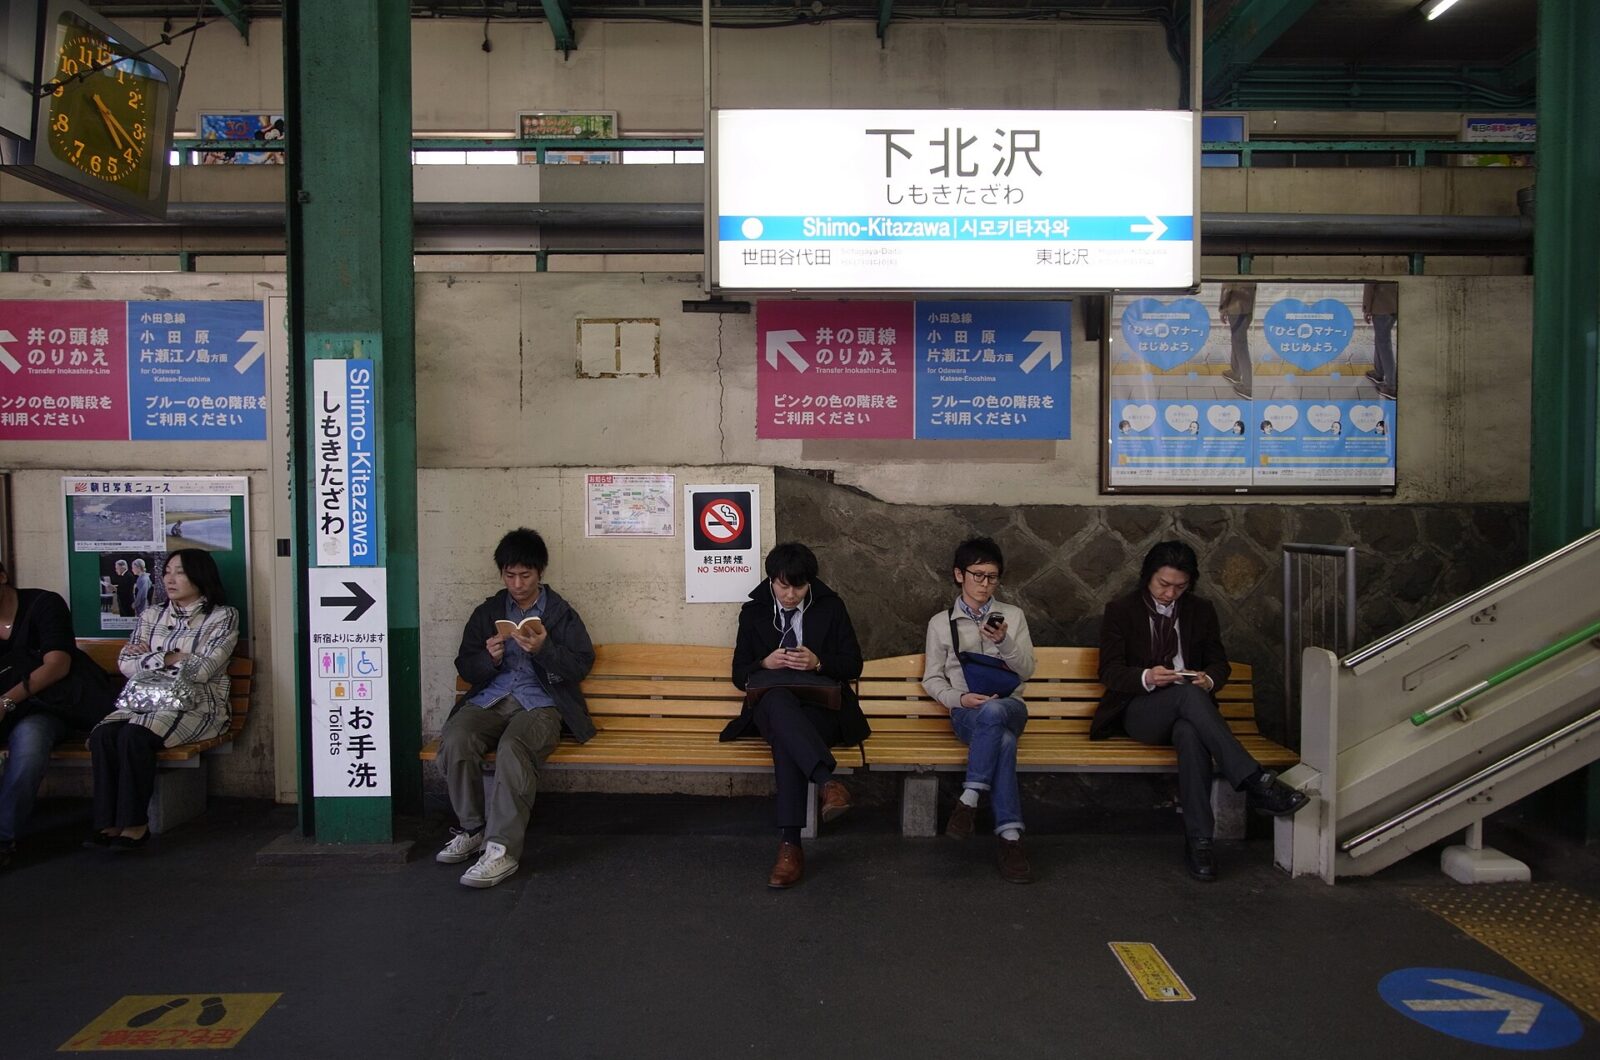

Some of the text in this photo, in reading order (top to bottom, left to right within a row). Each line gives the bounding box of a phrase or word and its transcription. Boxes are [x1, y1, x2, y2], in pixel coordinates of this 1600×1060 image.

[80, 46, 92, 68] 11
[62, 56, 78, 76] 10
[128, 91, 138, 109] 2
[58, 113, 69, 132] 8
[133, 123, 143, 140] 3
[74, 139, 85, 158] 7
[123, 147, 134, 164] 4
[866, 127, 1042, 178] 下北沢
[91, 155, 101, 172] 6
[107, 156, 118, 174] 5
[887, 184, 1024, 205] しもきたざわ
[803, 217, 951, 237] Shimo-Kitazawa
[961, 218, 1070, 238] 시모키타자와
[742, 249, 831, 265] 世田谷代田
[1036, 249, 1089, 265] 東北沢
[140, 312, 186, 324] 小田急線
[928, 312, 973, 324] 小田急線
[28, 327, 109, 345] 井の頭線
[140, 330, 210, 344] 小田原
[816, 327, 897, 346] 井の頭線
[927, 330, 996, 344] 小田原
[1139, 341, 1194, 352] はじめよう。
[1280, 342, 1338, 352] はじめよう。
[28, 348, 109, 366] のりかえ
[140, 348, 228, 363] 片瀬江ノ島方面
[815, 348, 896, 366] のりかえ
[927, 348, 1014, 363] 片瀬江ノ島方面
[28, 367, 110, 375] Transfer Inokashira-Line
[140, 367, 181, 375] for Odawara
[927, 367, 967, 375] for Odawara
[146, 396, 267, 410] ブルーの色の階段を
[774, 395, 898, 409] ピンクの色の階段を
[931, 395, 1054, 409] ブルーの色の階段を
[1, 413, 85, 426] 利用ください
[146, 413, 243, 426] ご利用ください
[774, 412, 870, 425] ご利用ください
[931, 412, 1027, 425] ご利用ください
[320, 390, 345, 535] しもきたざわ
[350, 368, 371, 556] Shimo-Kitazawa
[91, 482, 171, 493] 朝日写真ニュース
[703, 555, 743, 564] 終日禁煙
[313, 633, 385, 643] 新宿よりにあります
[329, 708, 343, 756] Toilets
[347, 706, 378, 788] お手洗
